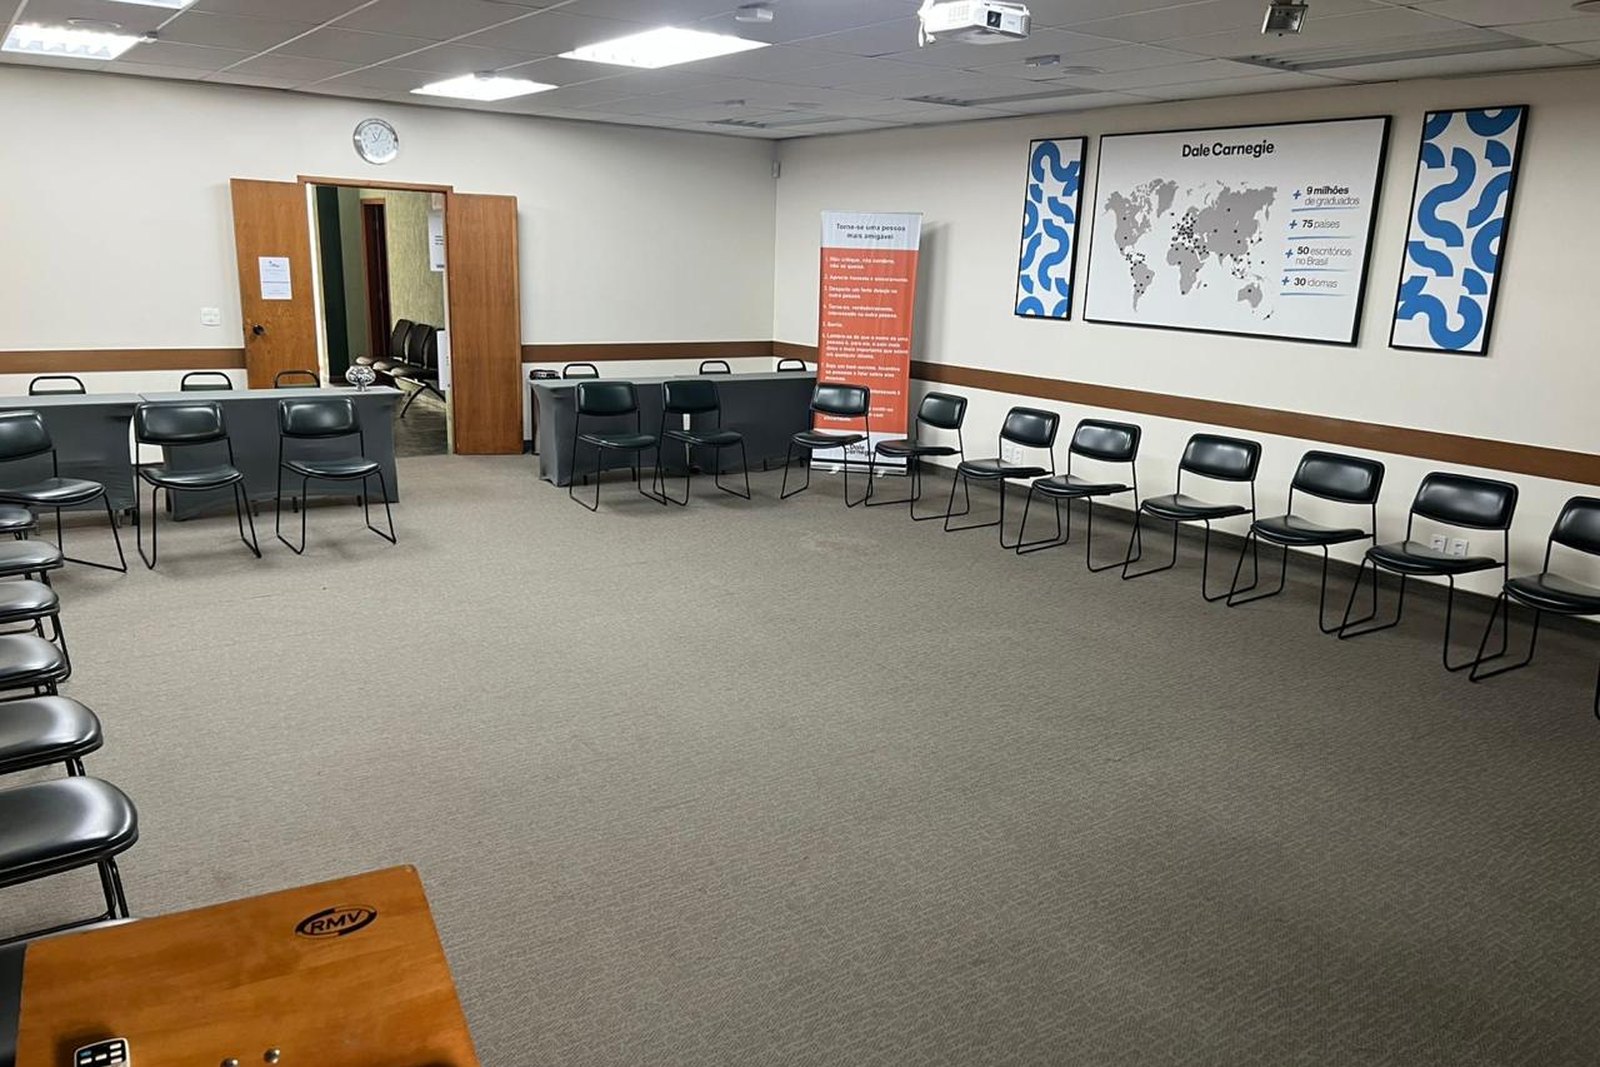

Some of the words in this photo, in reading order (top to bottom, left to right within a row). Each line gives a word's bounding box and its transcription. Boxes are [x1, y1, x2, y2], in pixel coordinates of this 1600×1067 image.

[1182, 143, 1210, 157] Dale
[1212, 140, 1274, 158] Carnegie
[1306, 186, 1313, 195] 9
[1305, 197, 1315, 205] de
[1316, 197, 1360, 207] graduados
[836, 223, 864, 231] Torne-se
[1302, 219, 1313, 228] 75
[1297, 246, 1309, 255] 50
[1296, 257, 1305, 265] no
[1307, 255, 1329, 265] Brasil
[1294, 277, 1306, 286] 30
[311, 909, 362, 935] RMV
